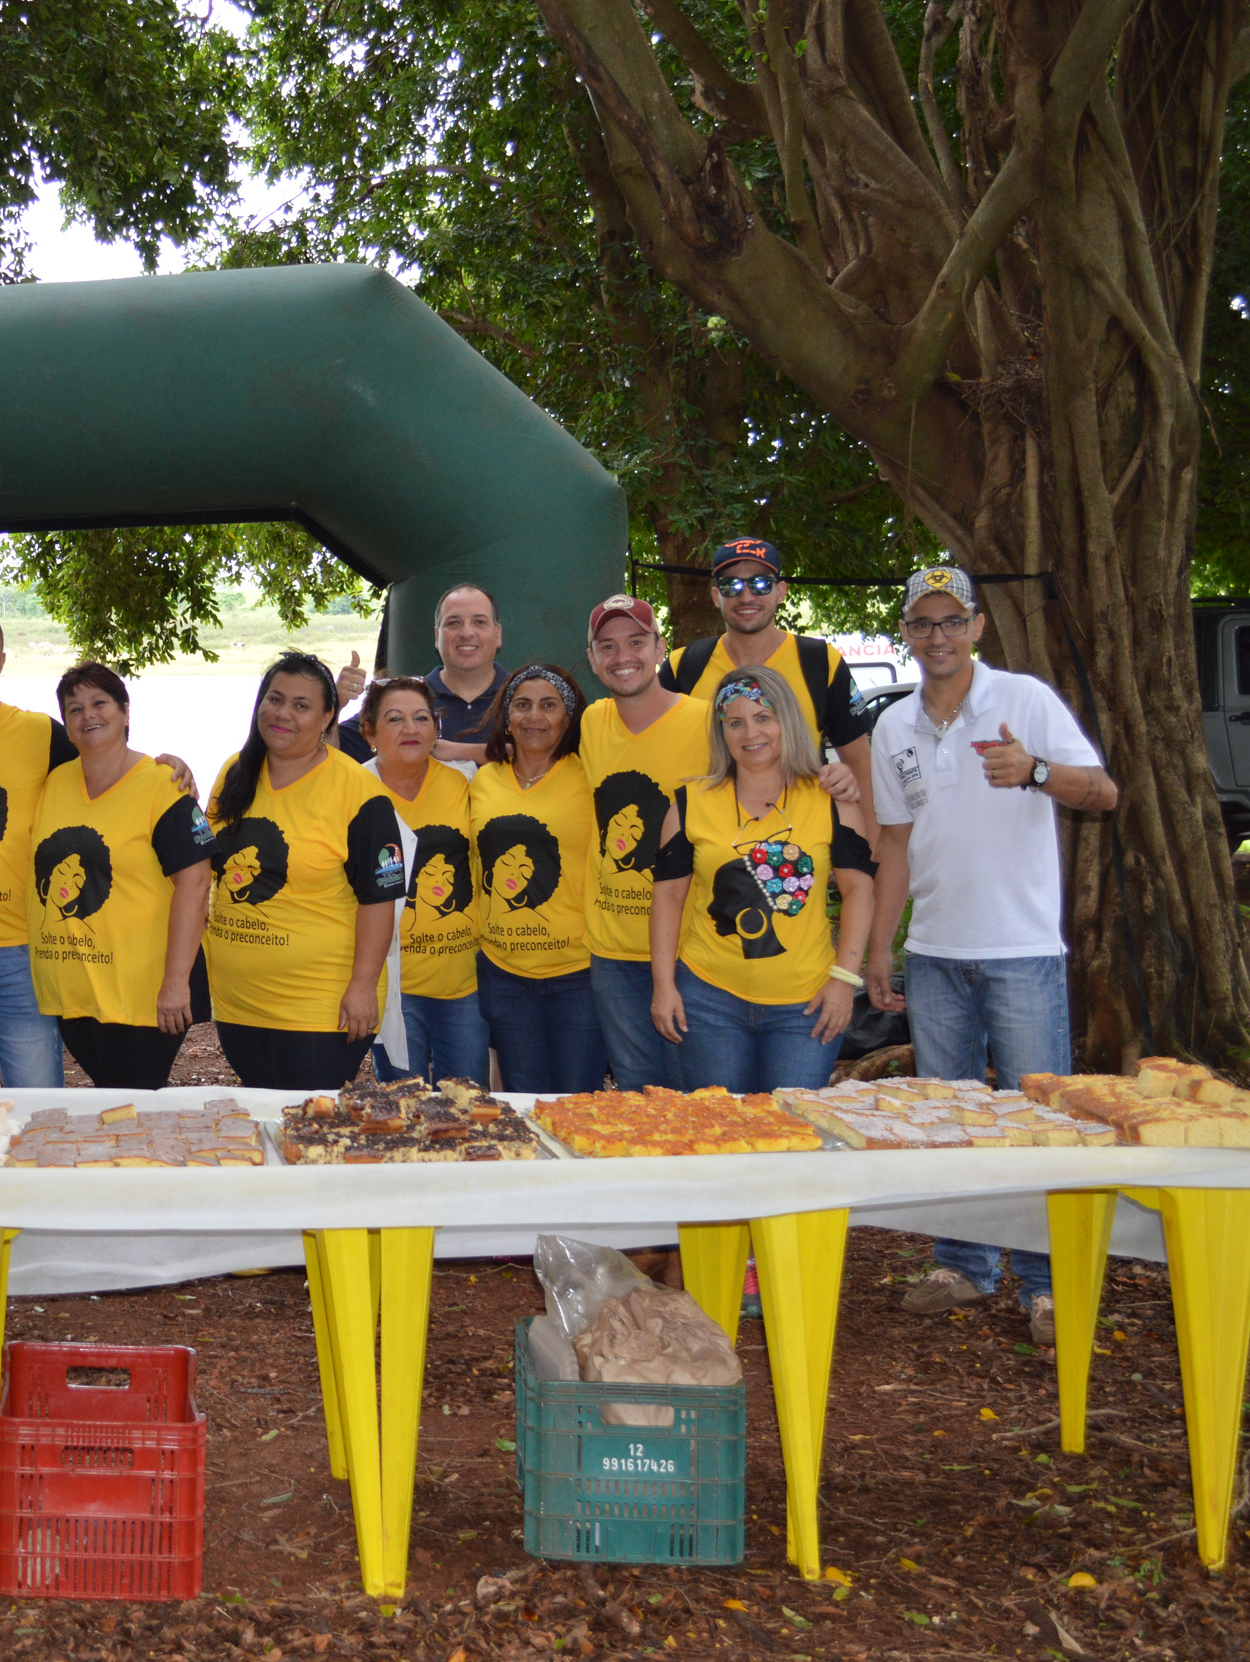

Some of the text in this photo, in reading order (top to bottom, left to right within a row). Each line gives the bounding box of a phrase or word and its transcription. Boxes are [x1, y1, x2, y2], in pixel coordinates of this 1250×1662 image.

[614, 888, 620, 898] o
[621, 886, 652, 901] cabelo
[228, 917, 234, 927] o
[236, 916, 270, 932] cabelo,
[487, 922, 550, 938] Solte o cabelo,
[41, 932, 58, 945] Solte
[59, 935, 66, 945] o
[224, 930, 229, 940] o
[230, 932, 290, 946] preconceito!
[410, 932, 435, 944] Solte
[437, 933, 444, 941] o
[503, 942, 508, 951] o
[510, 936, 570, 953] preconceito!
[54, 950, 60, 960] o
[429, 946, 436, 955] o
[628, 1443, 644, 1457] 12
[602, 1457, 675, 1472] 991617426
